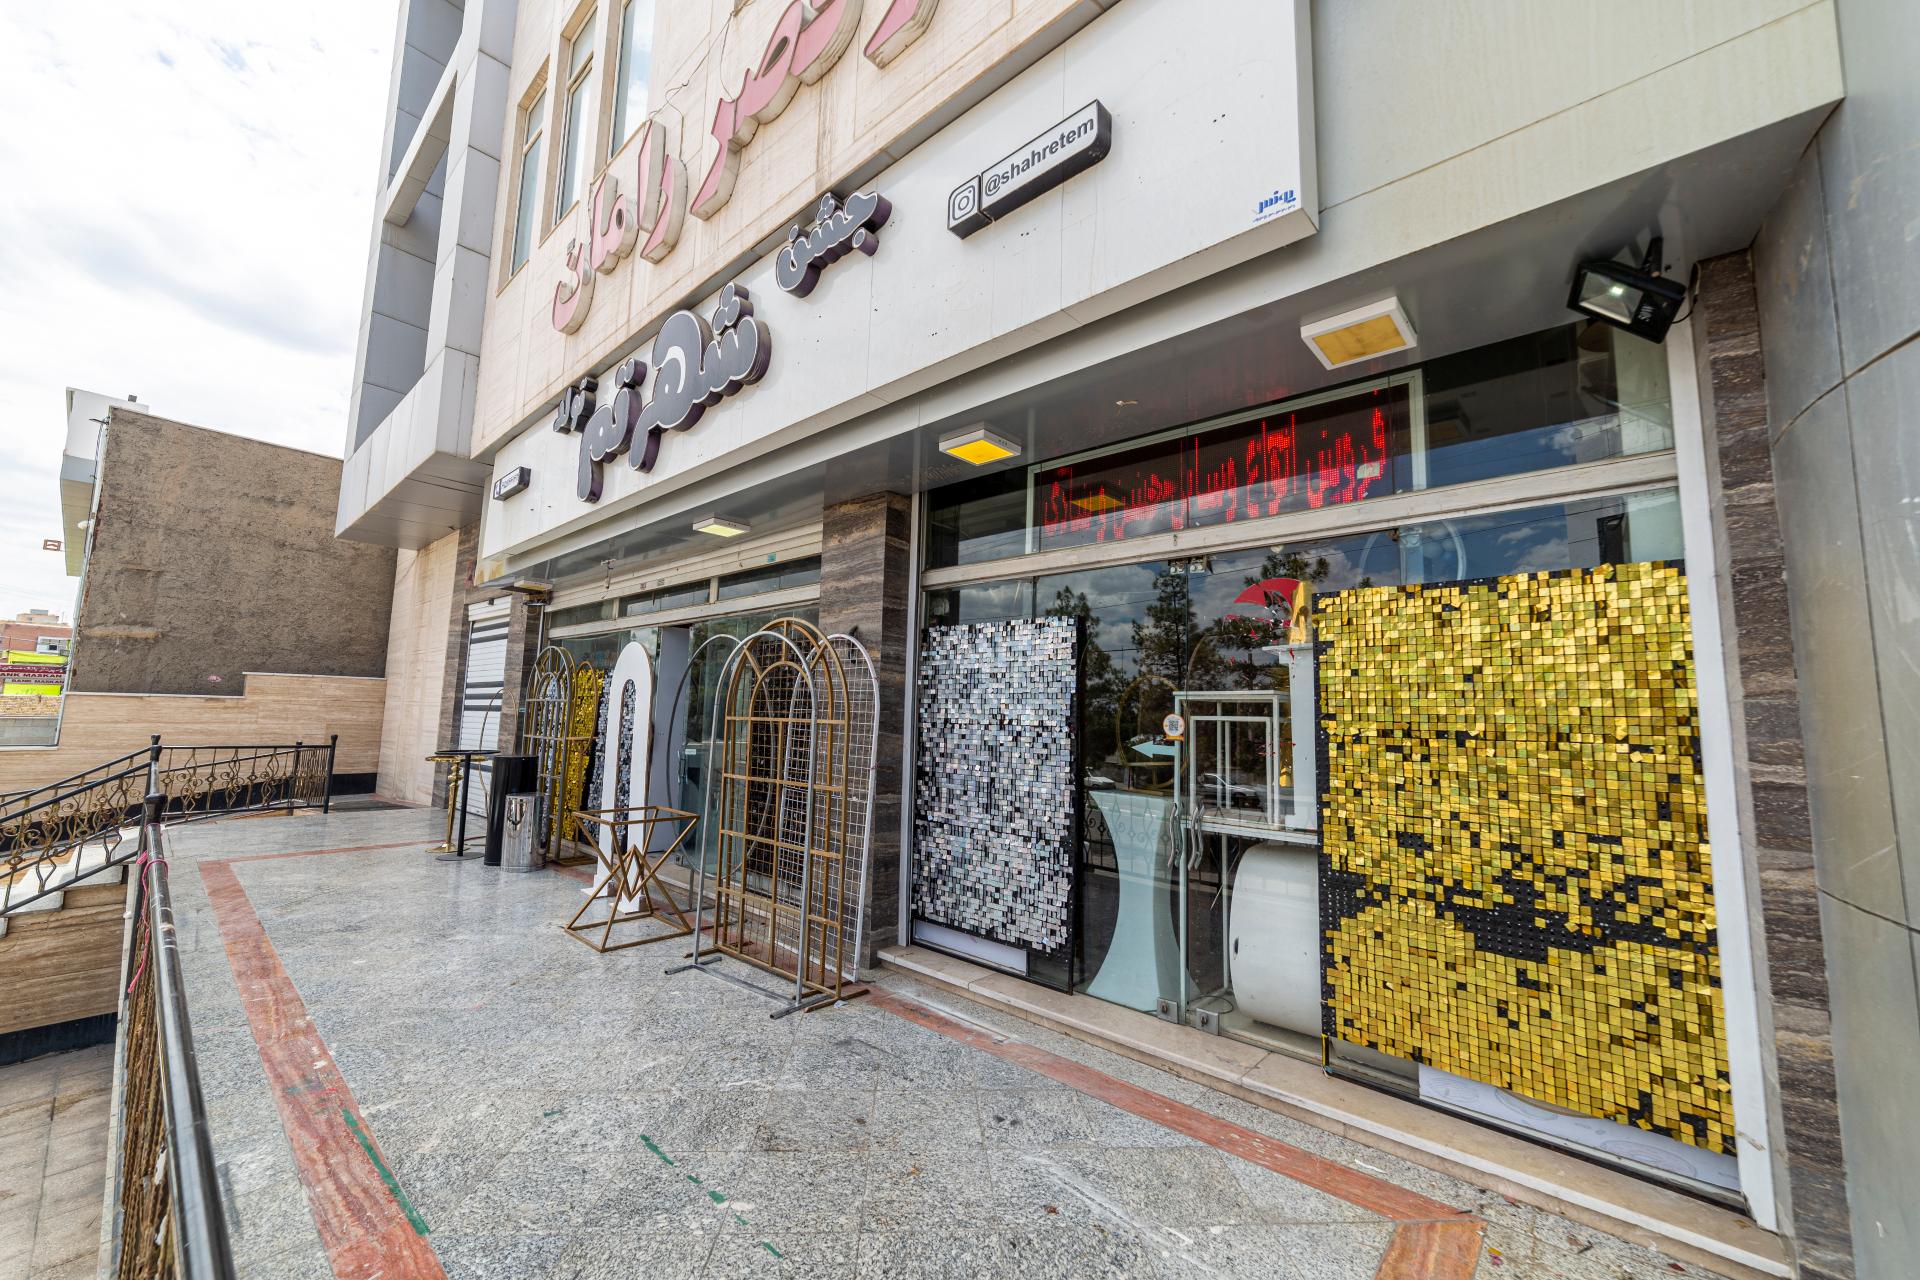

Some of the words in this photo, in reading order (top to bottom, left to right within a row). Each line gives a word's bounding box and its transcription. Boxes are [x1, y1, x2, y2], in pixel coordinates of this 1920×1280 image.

[985, 116, 1095, 197] @shahretem
[776, 191, 888, 299] جشن
[576, 358, 646, 504] تم
[628, 281, 768, 474] شهر
